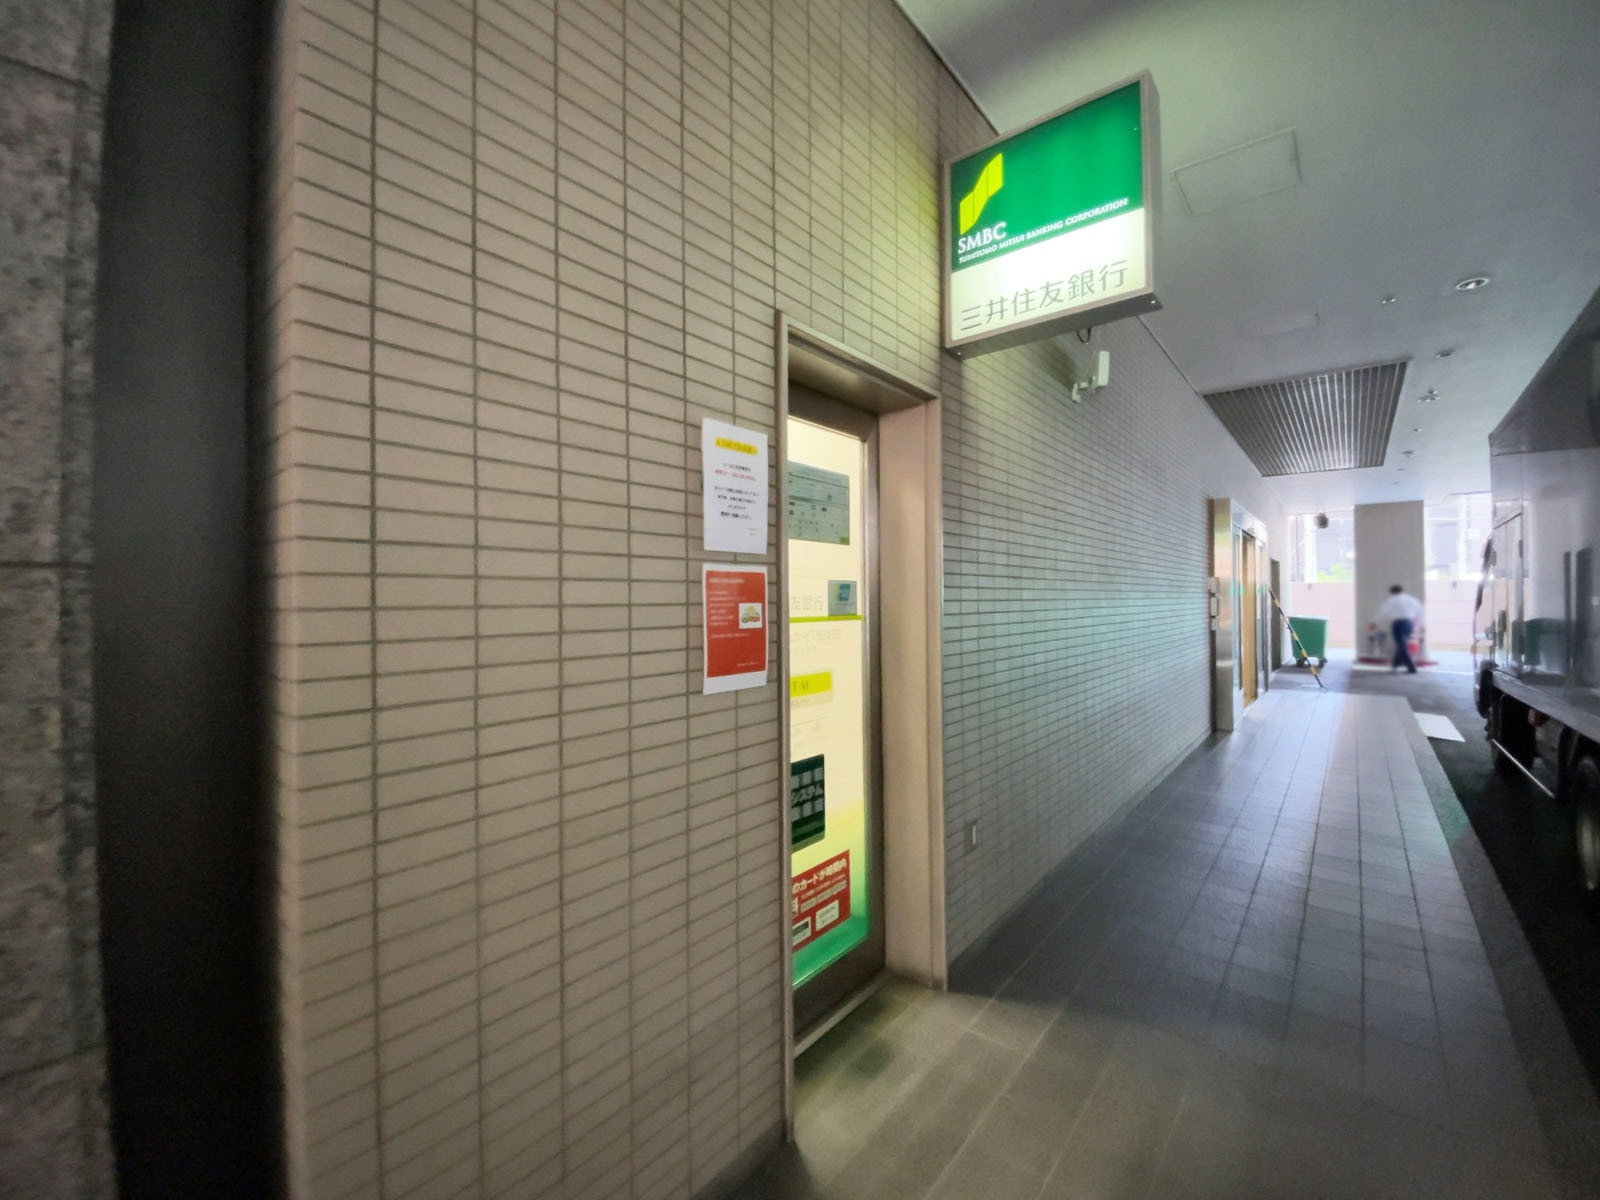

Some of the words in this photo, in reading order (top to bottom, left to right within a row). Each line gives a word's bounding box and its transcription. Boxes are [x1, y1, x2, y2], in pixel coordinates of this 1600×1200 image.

[958, 244, 998, 264] SUMITOMO
[998, 234, 1025, 249] MITSUI
[1026, 221, 1063, 239] BANKING
[1065, 198, 1129, 226] CORPORATION
[958, 221, 1007, 254] SMBC
[961, 259, 1128, 331] 三井住友銀行
